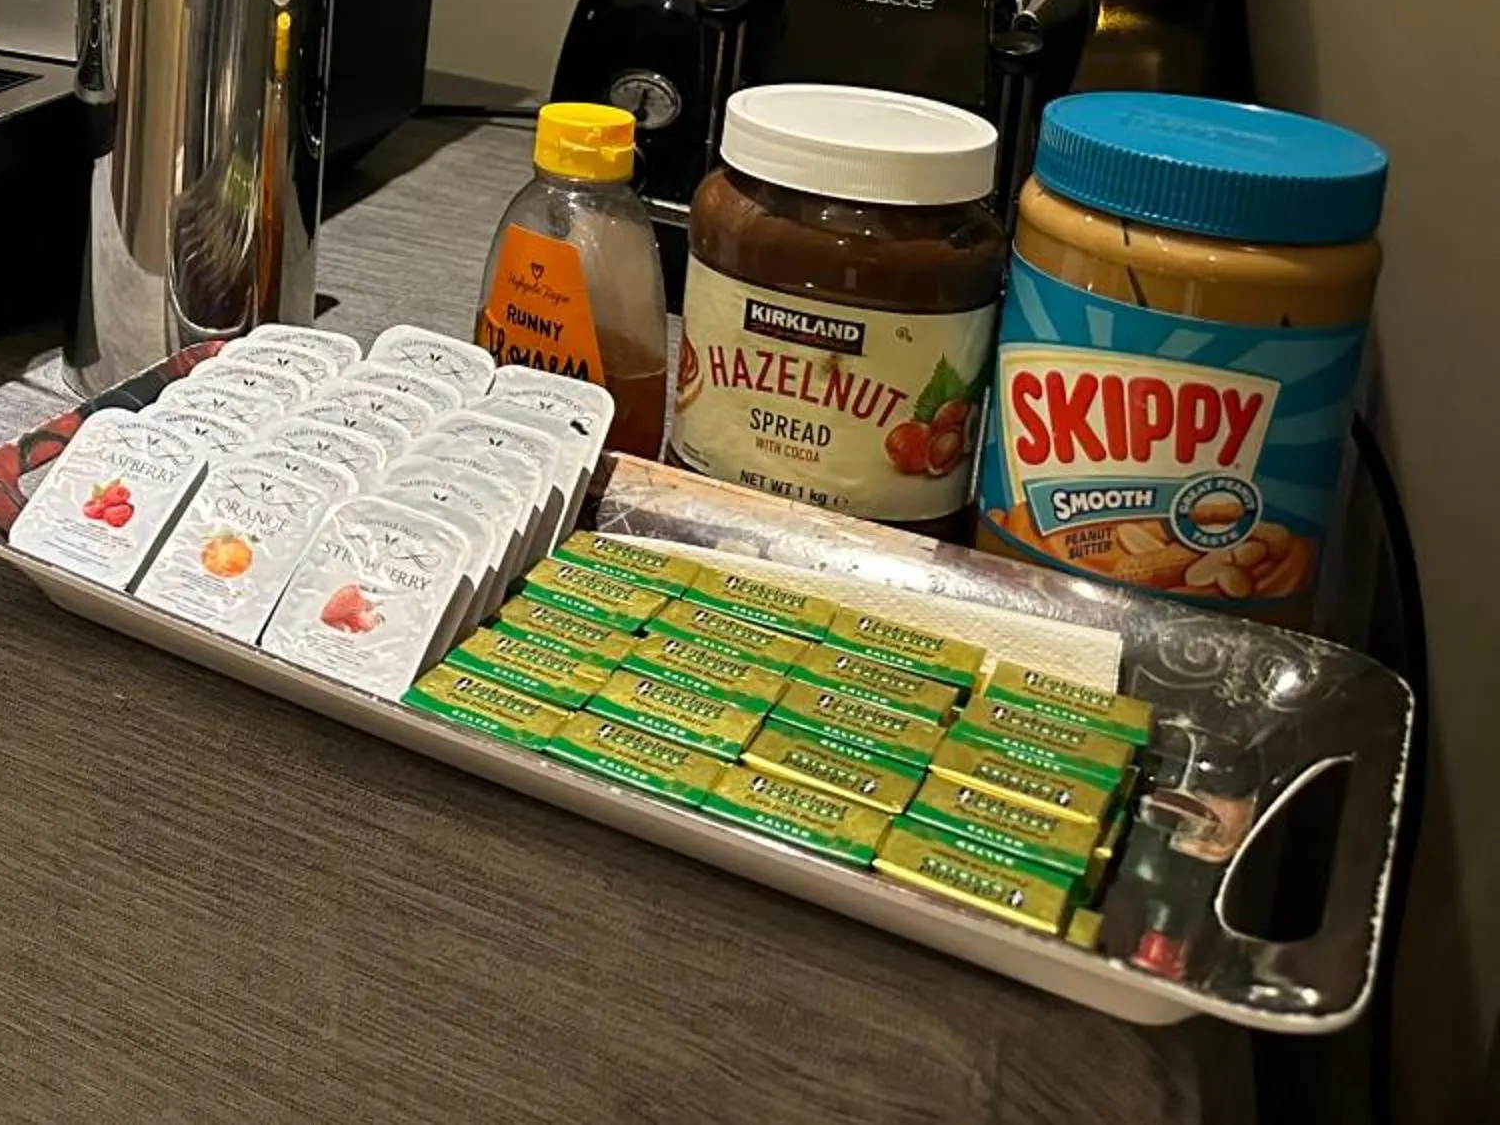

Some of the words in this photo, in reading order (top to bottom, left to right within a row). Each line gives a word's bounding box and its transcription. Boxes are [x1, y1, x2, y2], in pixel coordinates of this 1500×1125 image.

[506, 303, 564, 342] RUNNY
[750, 303, 860, 342] KIRKLAND
[708, 345, 909, 429] HAZELNUT
[749, 407, 832, 447] SPREAD
[1011, 370, 1264, 468] SKIPPY
[755, 436, 781, 456] WITH
[784, 445, 820, 464] COCOA
[739, 469, 767, 489] NET
[769, 479, 794, 497] WT
[809, 488, 828, 507] kg
[1053, 489, 1155, 521] SMOOTH
[1065, 526, 1113, 546] PEANUT
